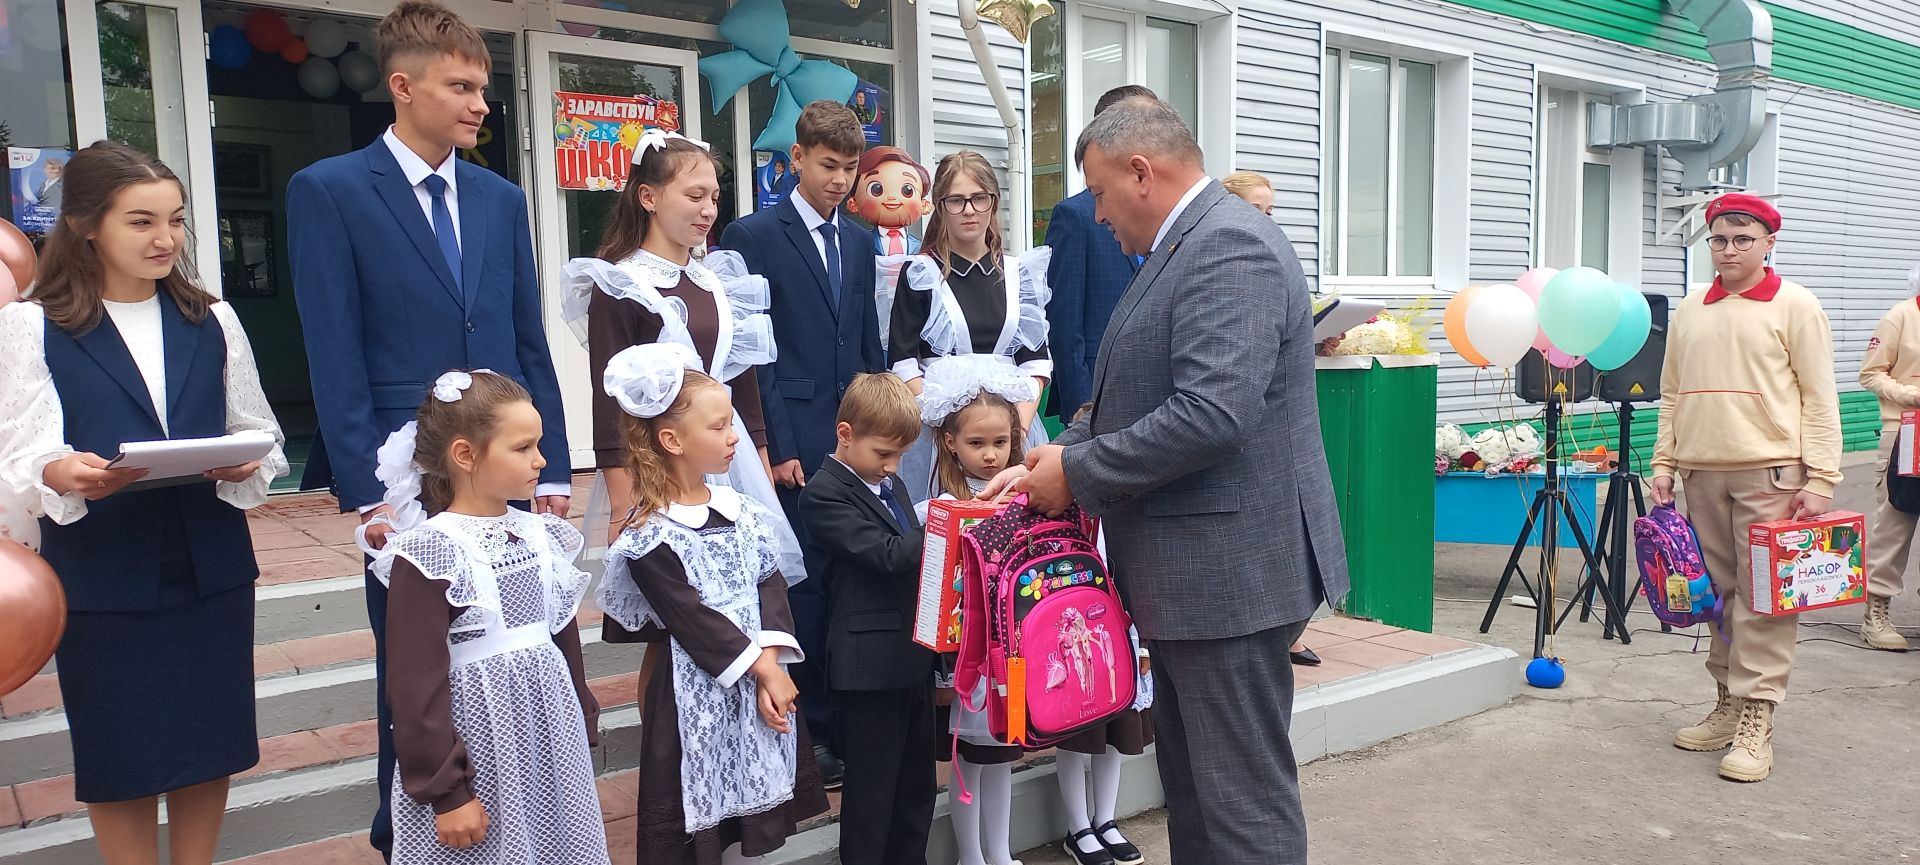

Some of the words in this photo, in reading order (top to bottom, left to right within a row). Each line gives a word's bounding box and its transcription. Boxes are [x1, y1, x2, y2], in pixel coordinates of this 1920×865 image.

[556, 140, 635, 189] ШКО
[1798, 562, 1841, 579] НАБОР
[1815, 584, 1826, 595] 36
[1079, 707, 1098, 719] Love
